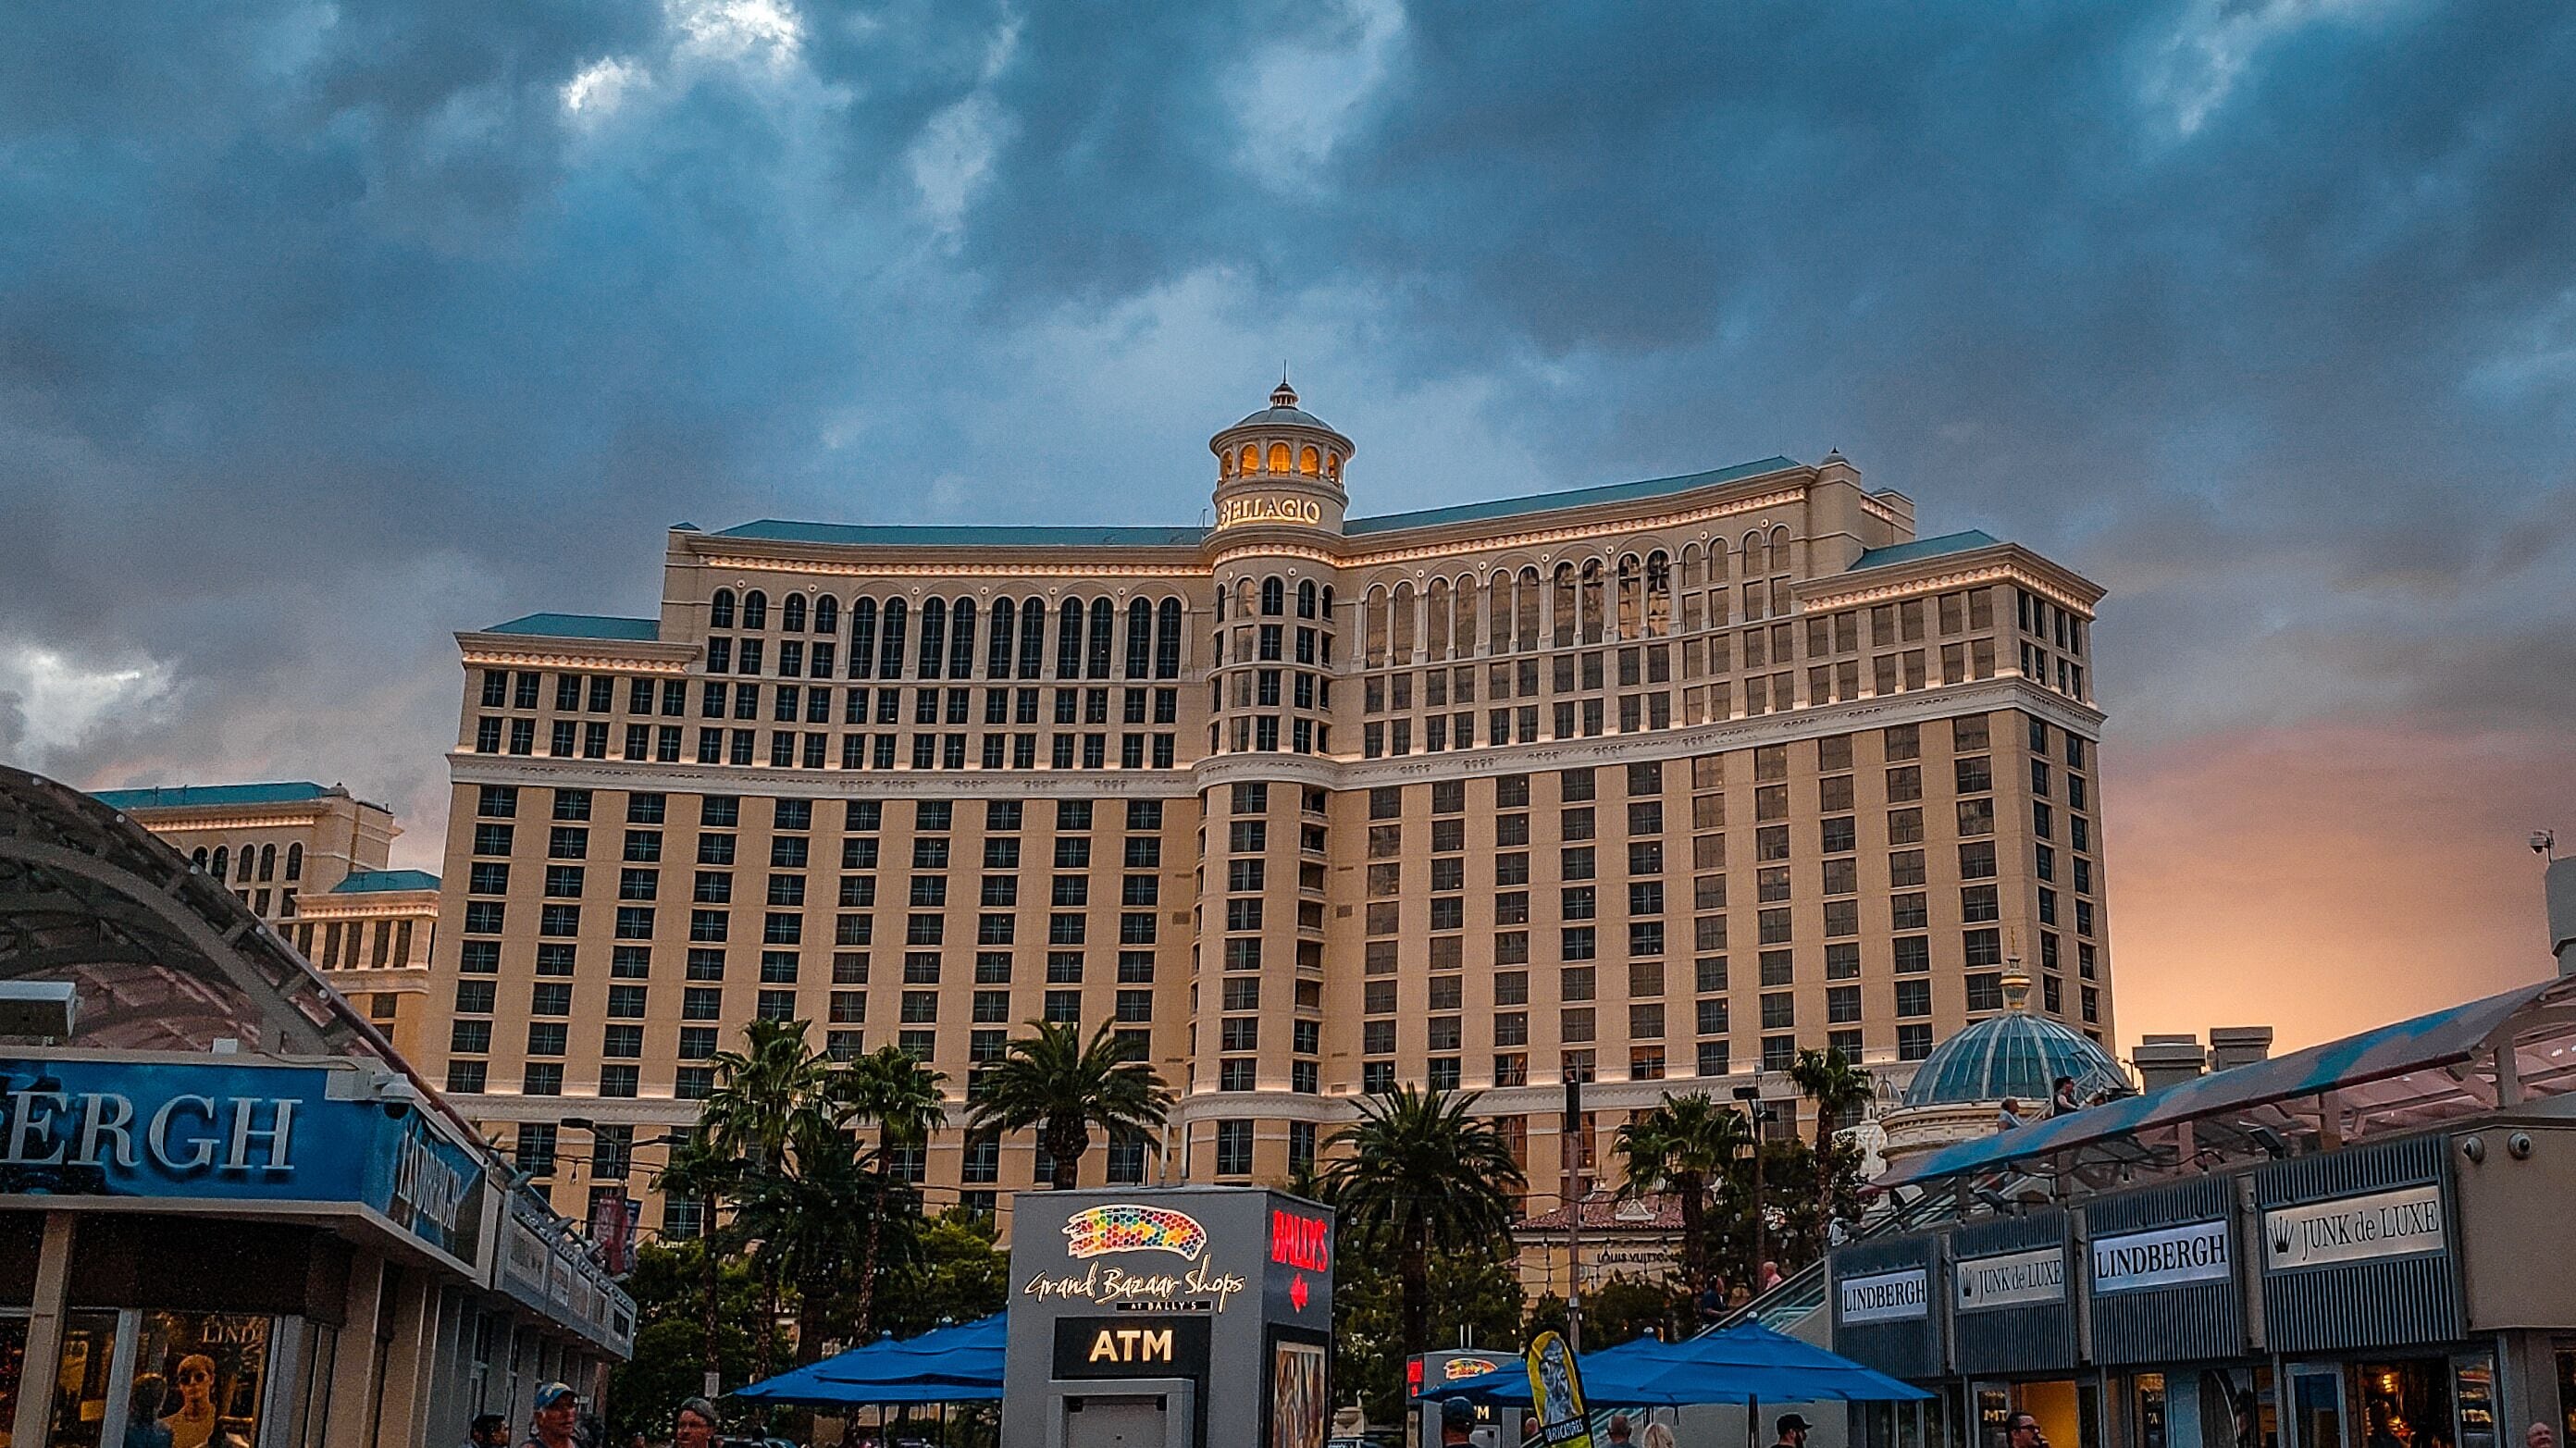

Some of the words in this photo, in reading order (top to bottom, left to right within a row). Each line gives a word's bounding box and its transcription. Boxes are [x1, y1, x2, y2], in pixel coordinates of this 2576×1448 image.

[1217, 497, 1321, 532] BELLAGIO
[0, 1090, 303, 1170] ERGH
[398, 1128, 462, 1231] LINDBERGH
[1271, 1209, 1329, 1273] BALLY'S
[2301, 1221, 2351, 1261] JUNK
[2355, 1211, 2376, 1242] de
[2381, 1200, 2439, 1239] LUXE
[1597, 1252, 1628, 1263] LOUIS
[1629, 1252, 1669, 1263] VUITTO
[2095, 1232, 2227, 1280] LINDBERGH
[1024, 1260, 1099, 1303] Grand
[1094, 1268, 1183, 1306] Bazaar
[1183, 1252, 1247, 1314] Shops
[1844, 1279, 1926, 1313] LINDBERGH
[1978, 1266, 2011, 1304] JUNK
[2012, 1267, 2025, 1289] de
[2027, 1259, 2062, 1288] LUXE
[1147, 1301, 1197, 1311] BALLY'S
[1089, 1330, 1172, 1363] ATM
